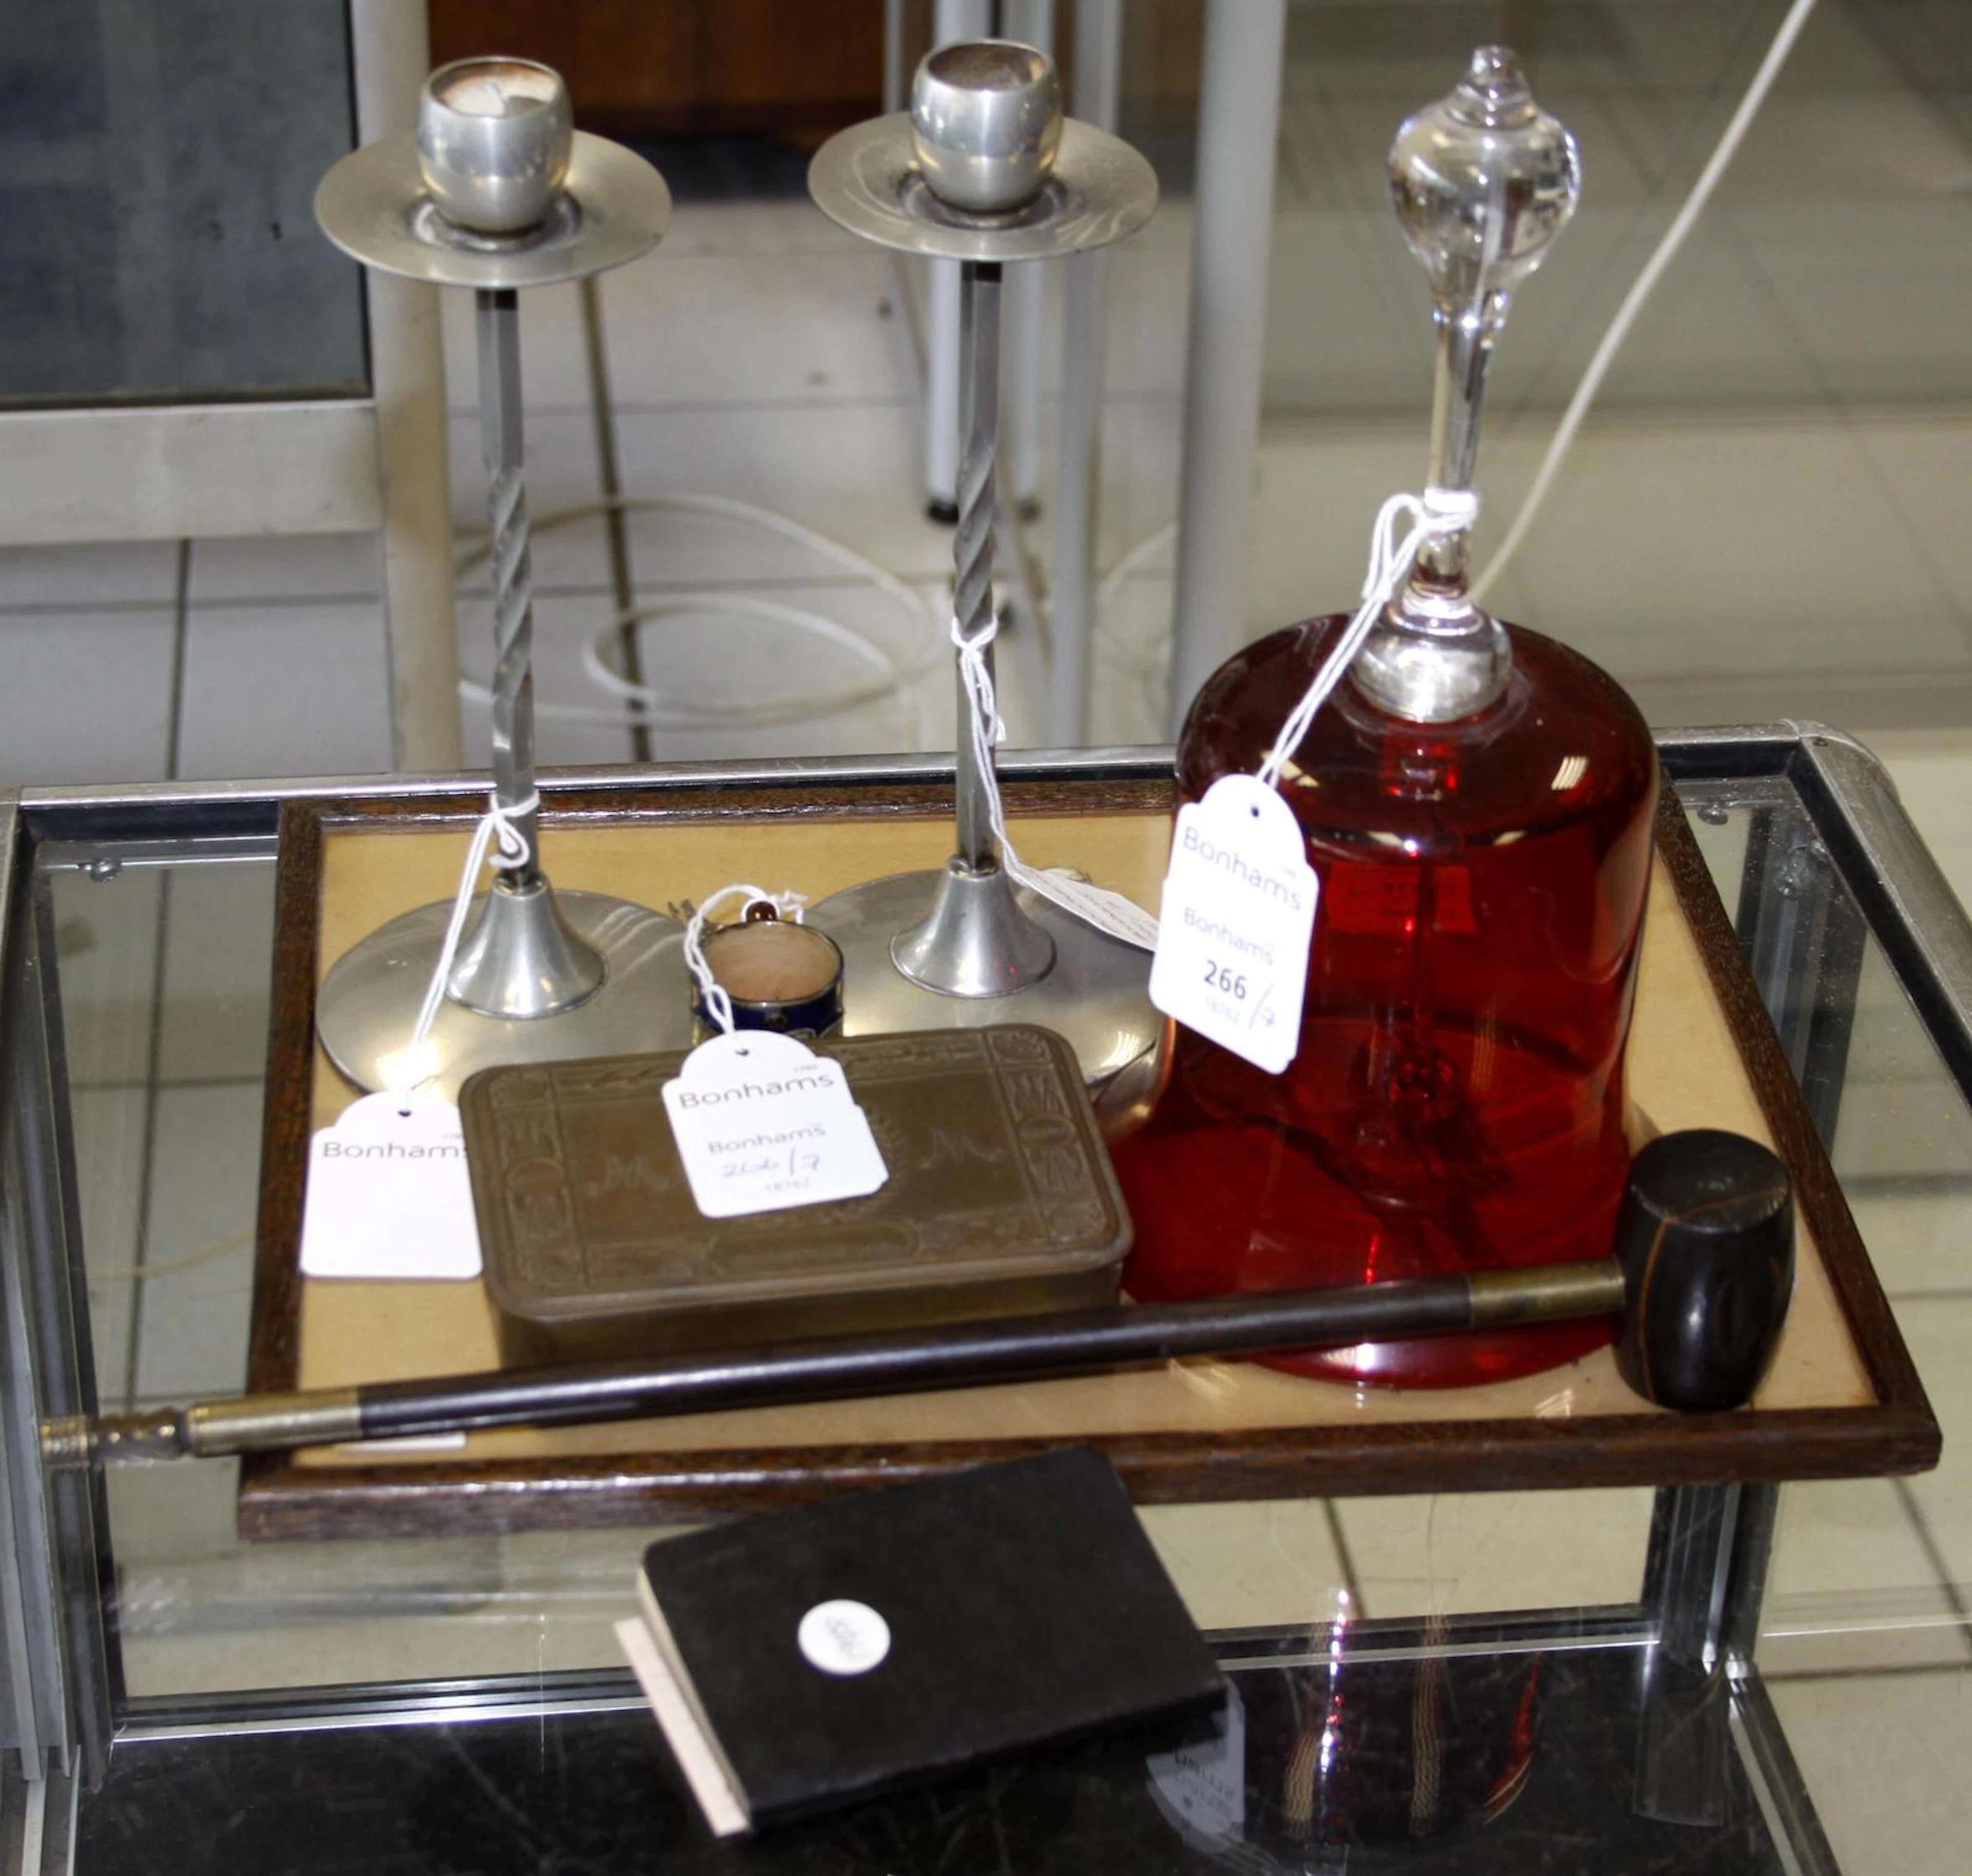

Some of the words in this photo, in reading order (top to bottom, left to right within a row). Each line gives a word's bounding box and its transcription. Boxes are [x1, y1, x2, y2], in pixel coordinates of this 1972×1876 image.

[1183, 825, 1302, 912] Bonhams
[1183, 907, 1274, 966] Bonhams
[1203, 959, 1247, 1000] 266
[678, 1074, 835, 1109] Bonhams
[707, 1129, 827, 1155] Bonhams
